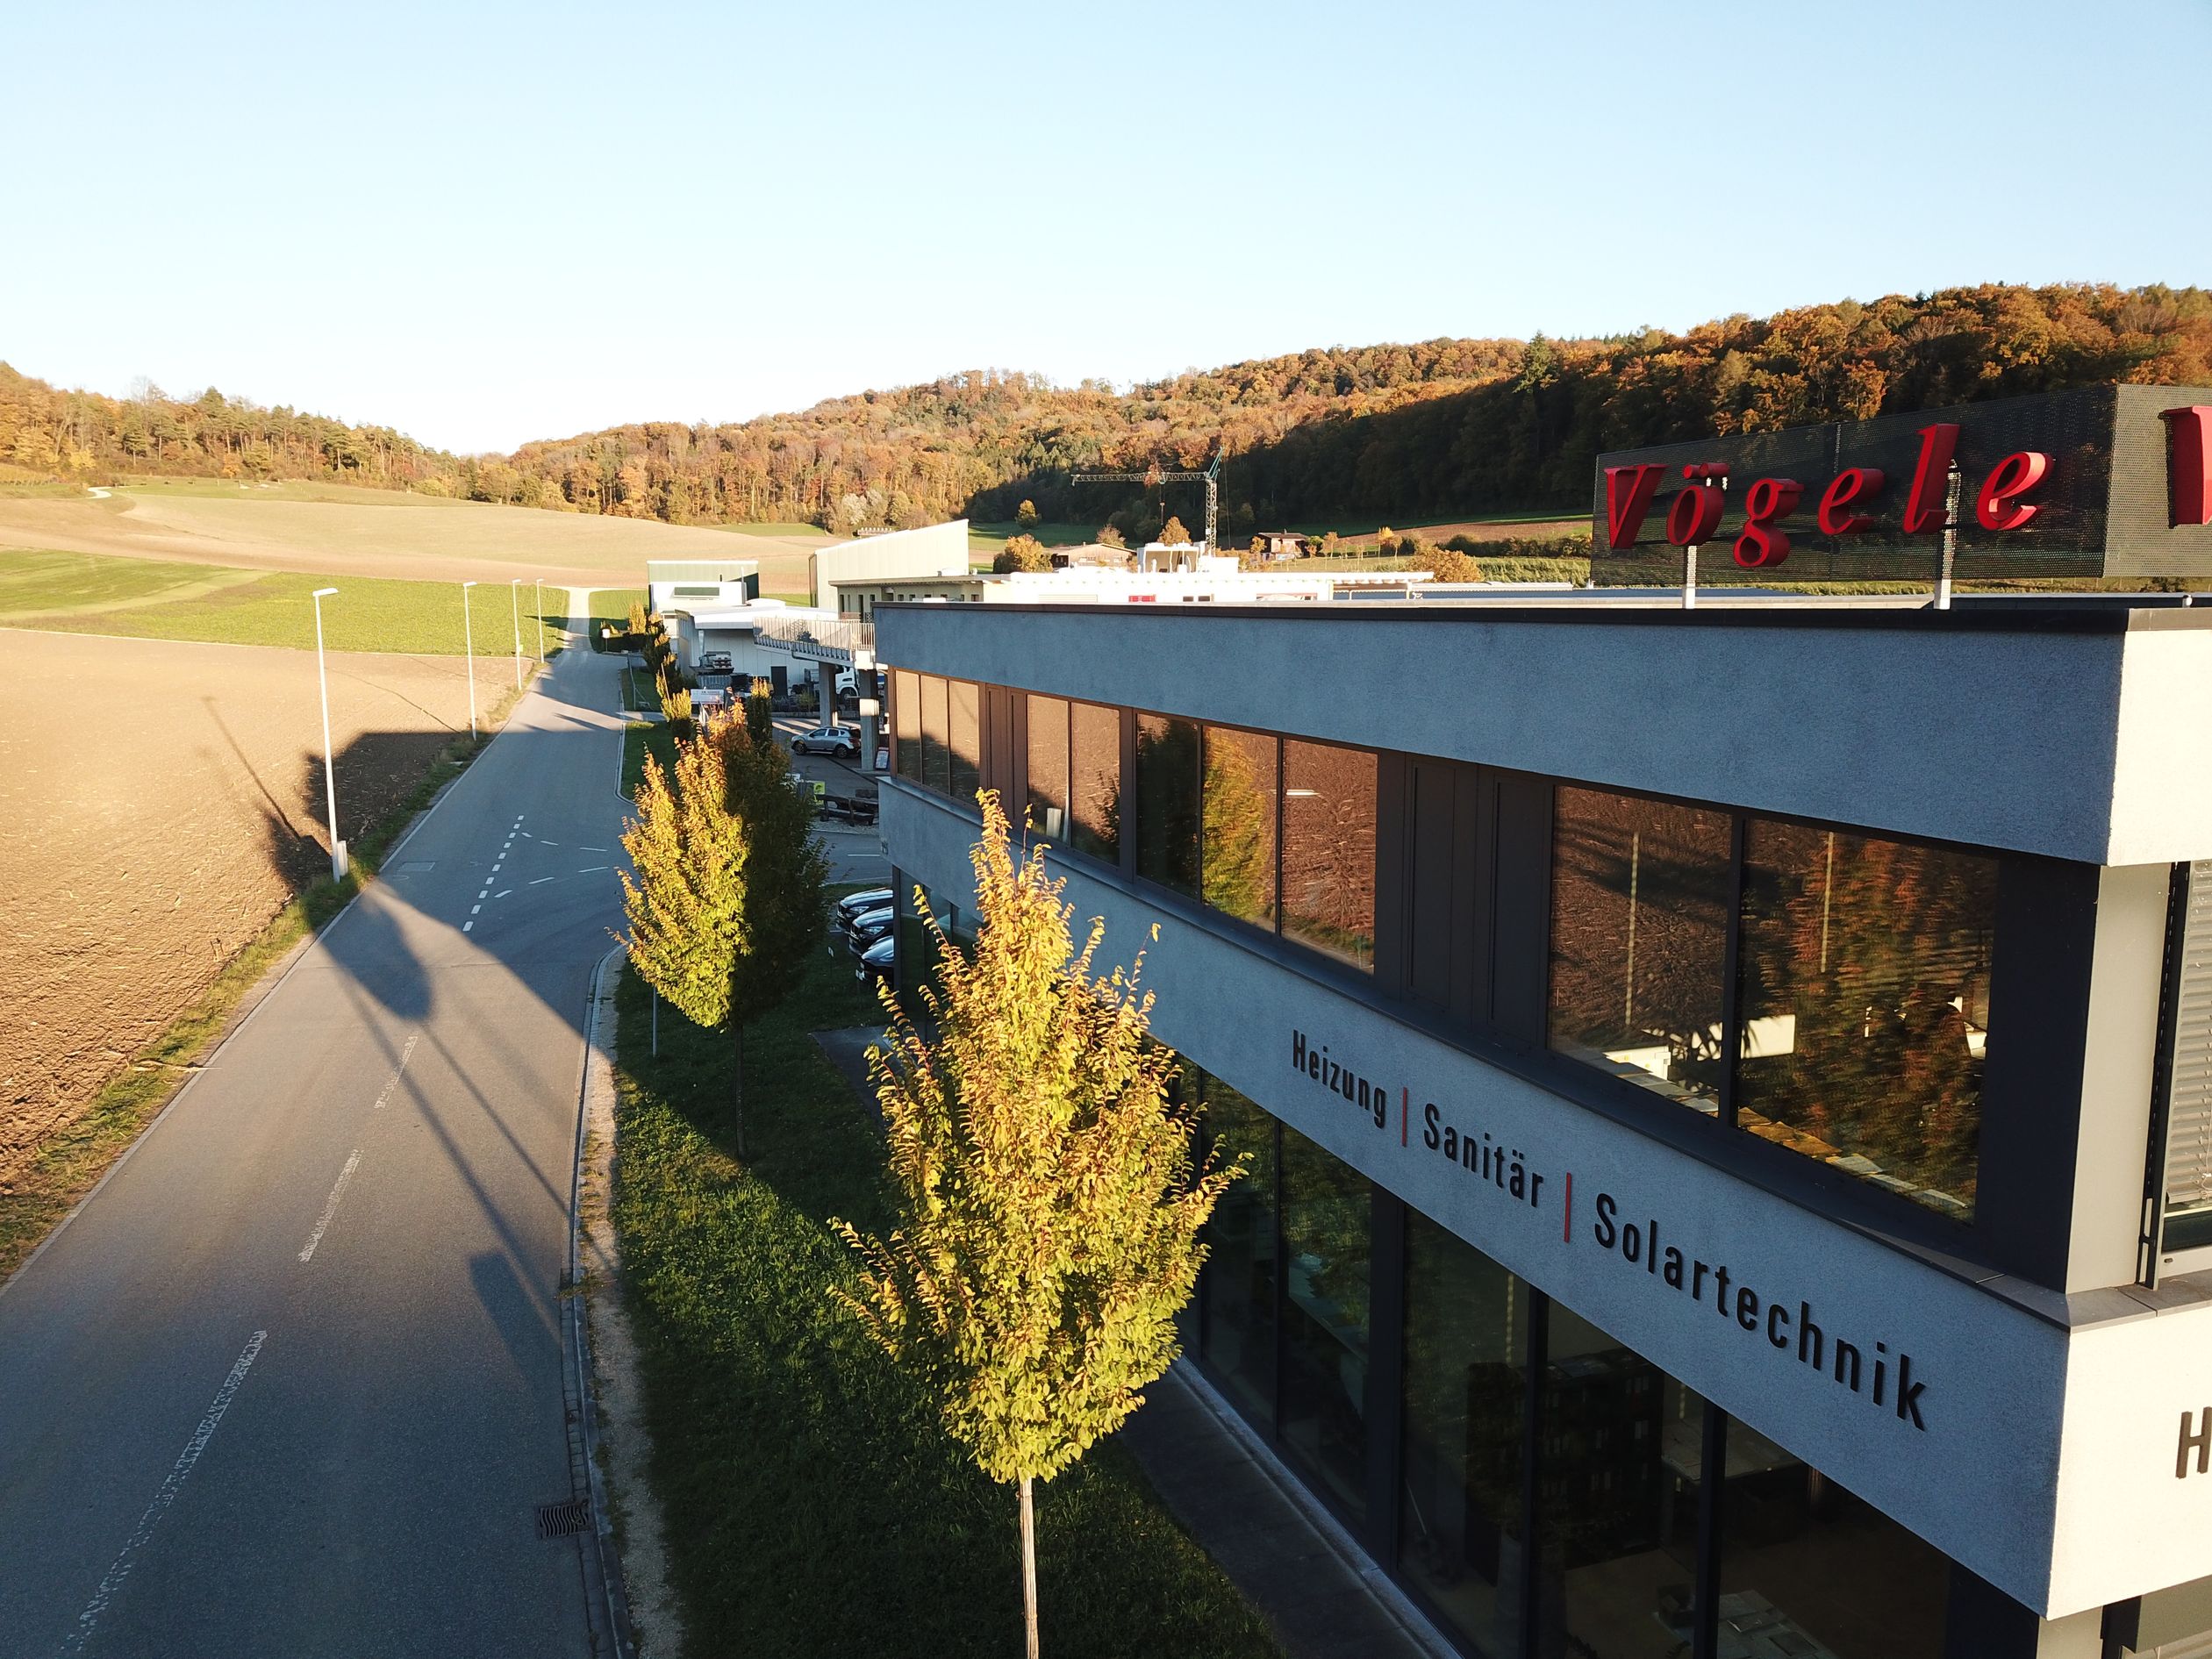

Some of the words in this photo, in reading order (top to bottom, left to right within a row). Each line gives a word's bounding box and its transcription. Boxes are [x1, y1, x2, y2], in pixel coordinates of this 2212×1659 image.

[1604, 422, 2054, 568] Vögele
[1292, 1029, 1387, 1129] Heizung
[1423, 1103, 1545, 1208] Sanitär
[1593, 1192, 1928, 1432] Solartechnik
